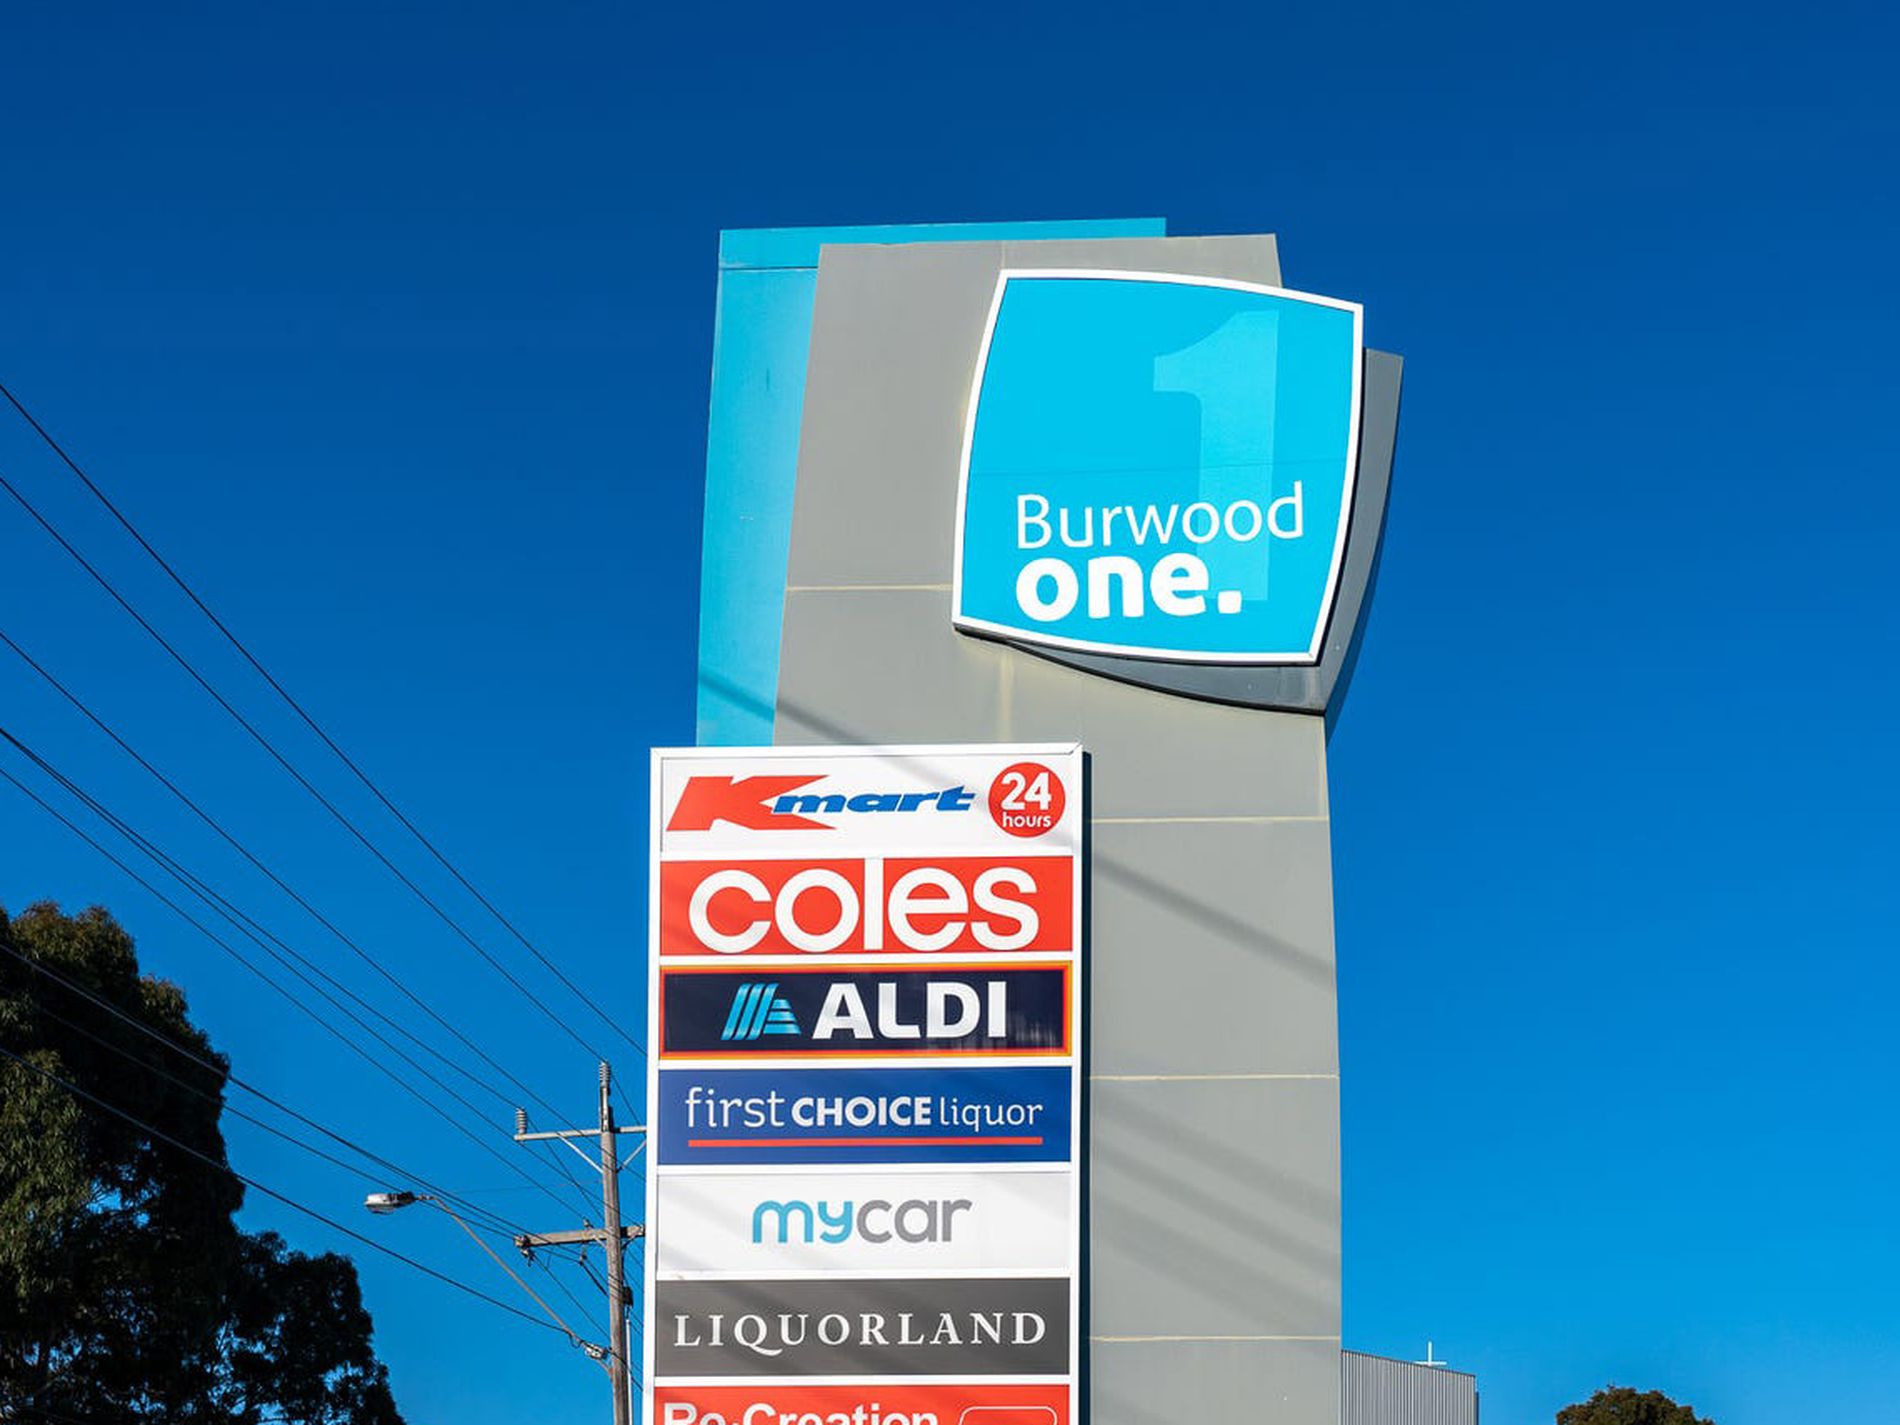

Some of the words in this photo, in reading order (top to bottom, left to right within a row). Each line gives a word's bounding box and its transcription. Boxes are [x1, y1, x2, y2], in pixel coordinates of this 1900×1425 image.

[1016, 480, 1304, 549] Burwood
[1015, 552, 1242, 622] one.
[665, 774, 975, 831] Kmart
[1001, 772, 1052, 811] 24
[1002, 812, 1051, 829] hours
[688, 857, 1039, 954] coles
[812, 981, 1007, 1039] ALDI
[685, 1087, 785, 1128] first
[791, 1096, 931, 1127] CHOICE
[940, 1097, 1043, 1132] liquor
[752, 1199, 972, 1244] mycar
[673, 1312, 1046, 1357] LIQUORLAND
